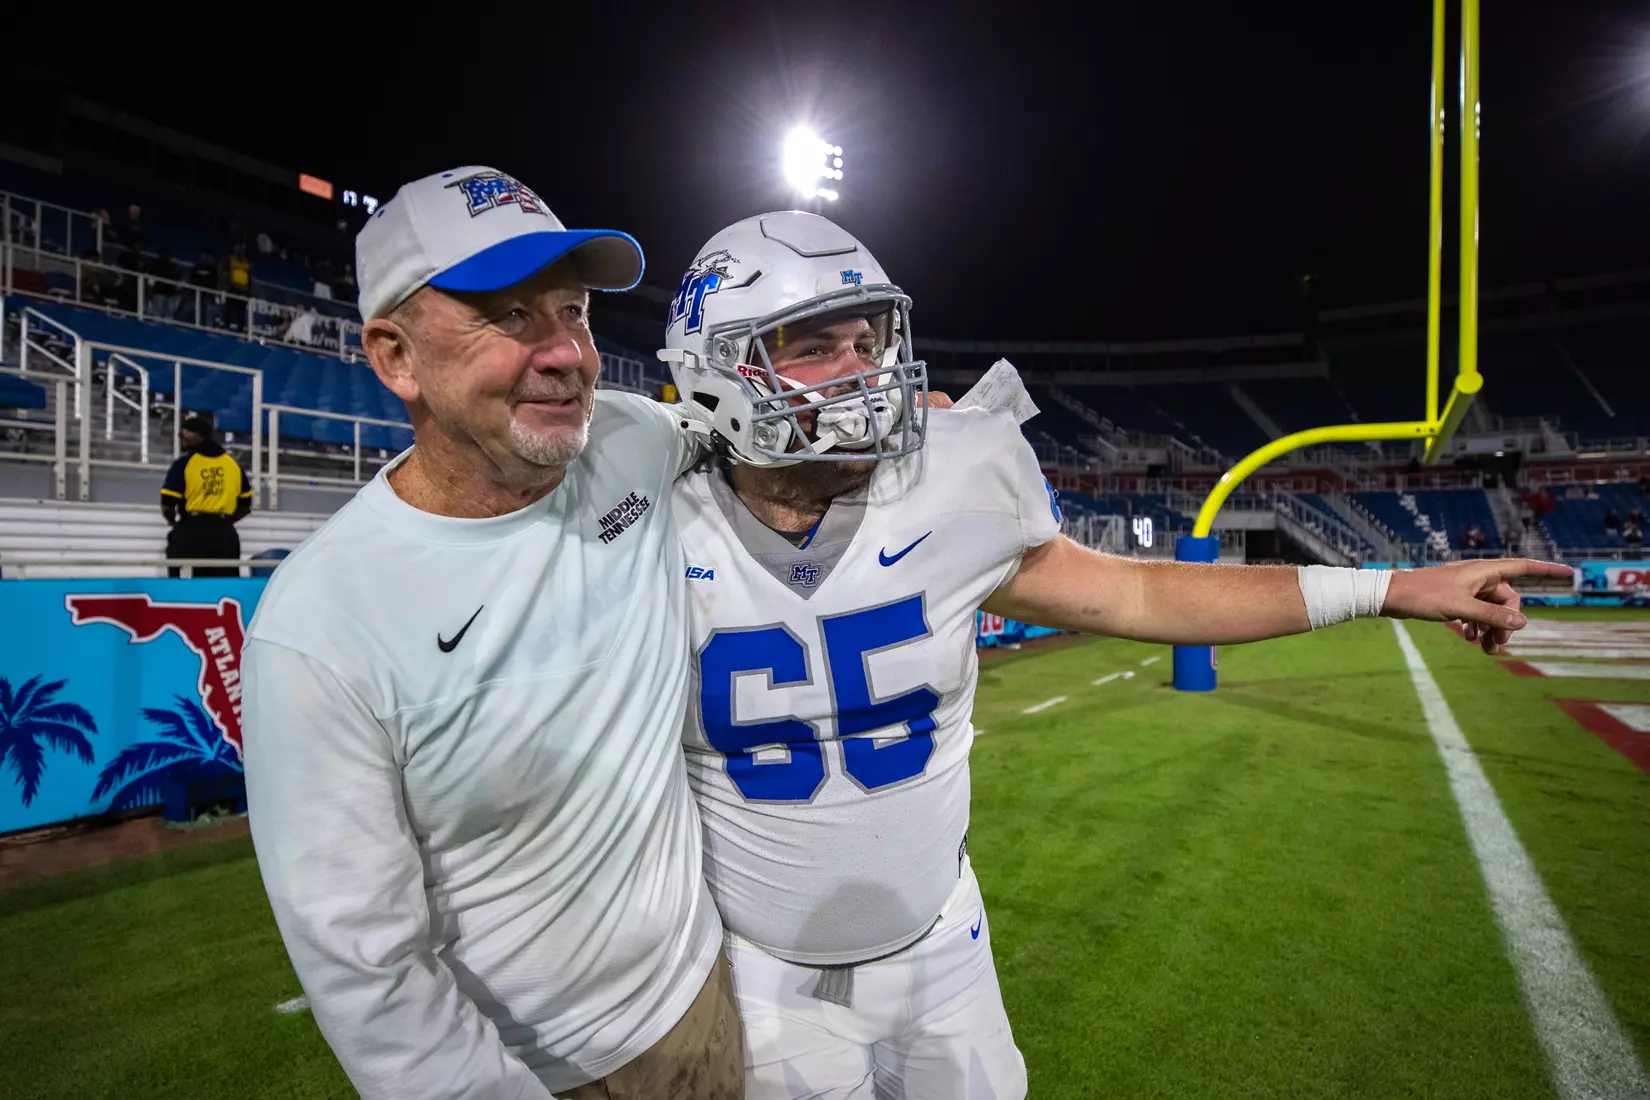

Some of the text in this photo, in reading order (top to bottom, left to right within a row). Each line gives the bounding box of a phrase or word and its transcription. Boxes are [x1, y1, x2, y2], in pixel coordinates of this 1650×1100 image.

[841, 269, 863, 287] MT
[598, 491, 640, 531] MIDDLE
[598, 495, 650, 545] TENNESSEE
[1132, 518, 1152, 547] 40
[790, 562, 821, 586] MT
[204, 626, 242, 725] ATLAN
[696, 590, 944, 805] 65
